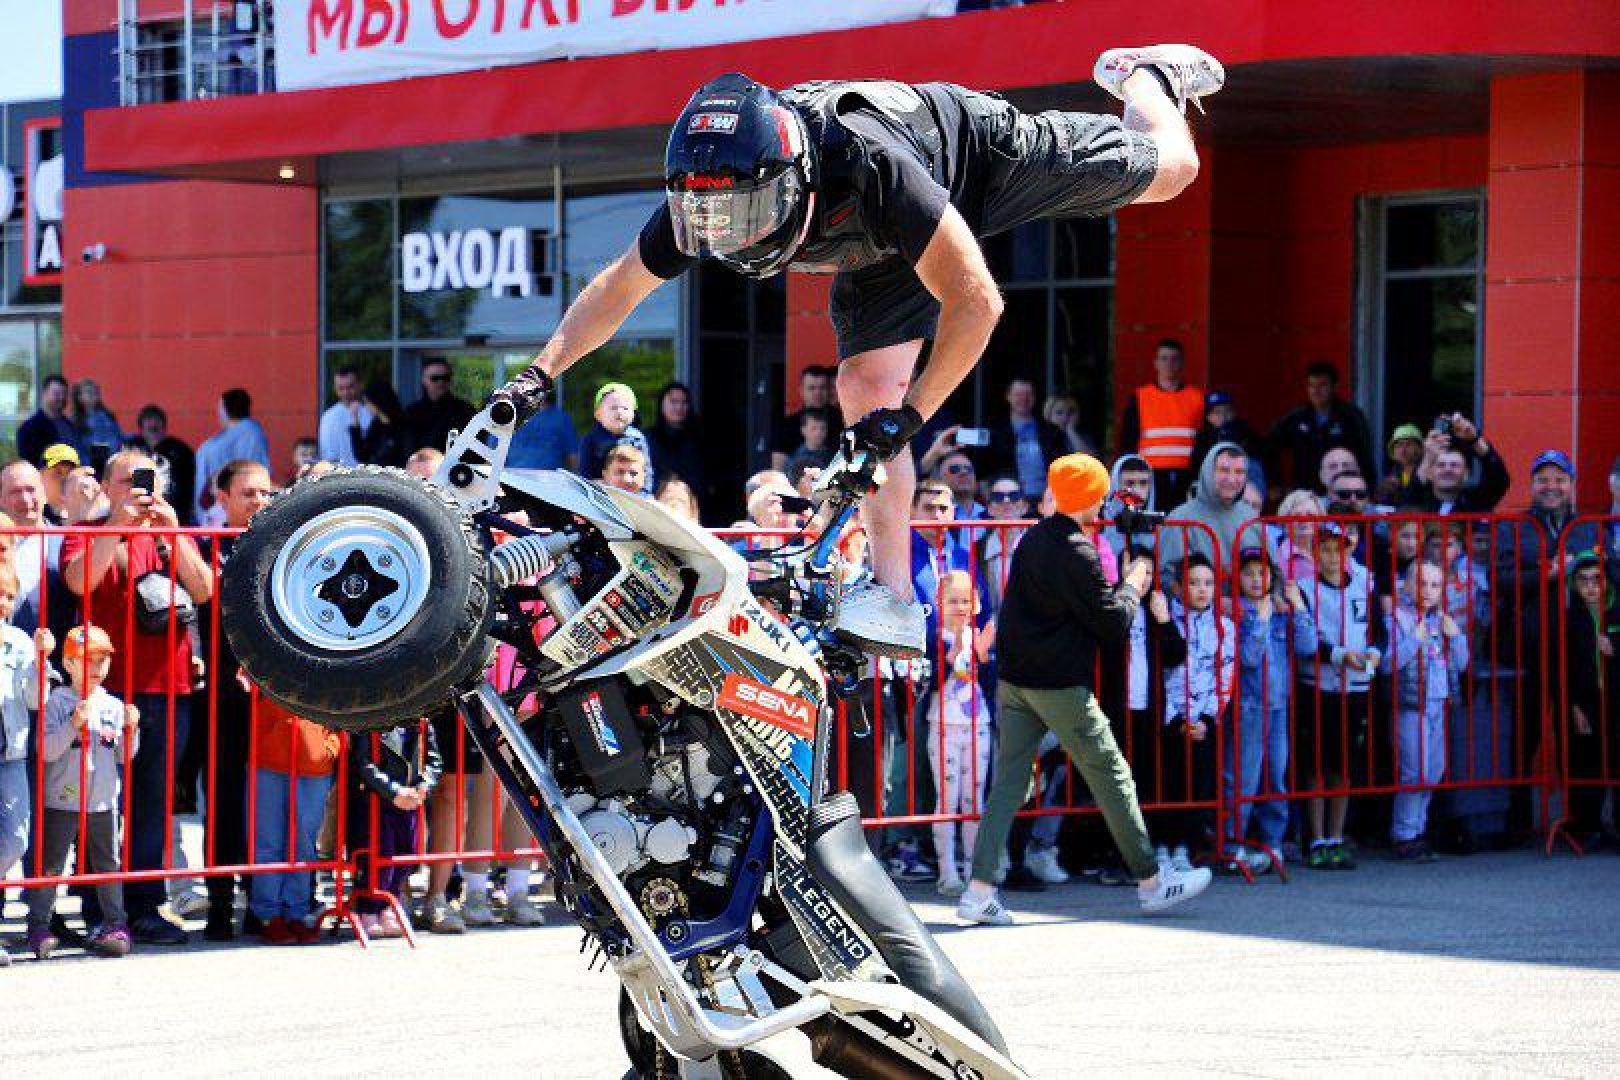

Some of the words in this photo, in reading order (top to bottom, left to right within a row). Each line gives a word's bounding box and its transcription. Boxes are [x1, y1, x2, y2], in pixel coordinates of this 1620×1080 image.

[403, 227, 531, 297] ВХОД
[740, 600, 791, 653] ZUKI
[735, 682, 809, 724] SENA
[793, 877, 865, 959] LEGEND
